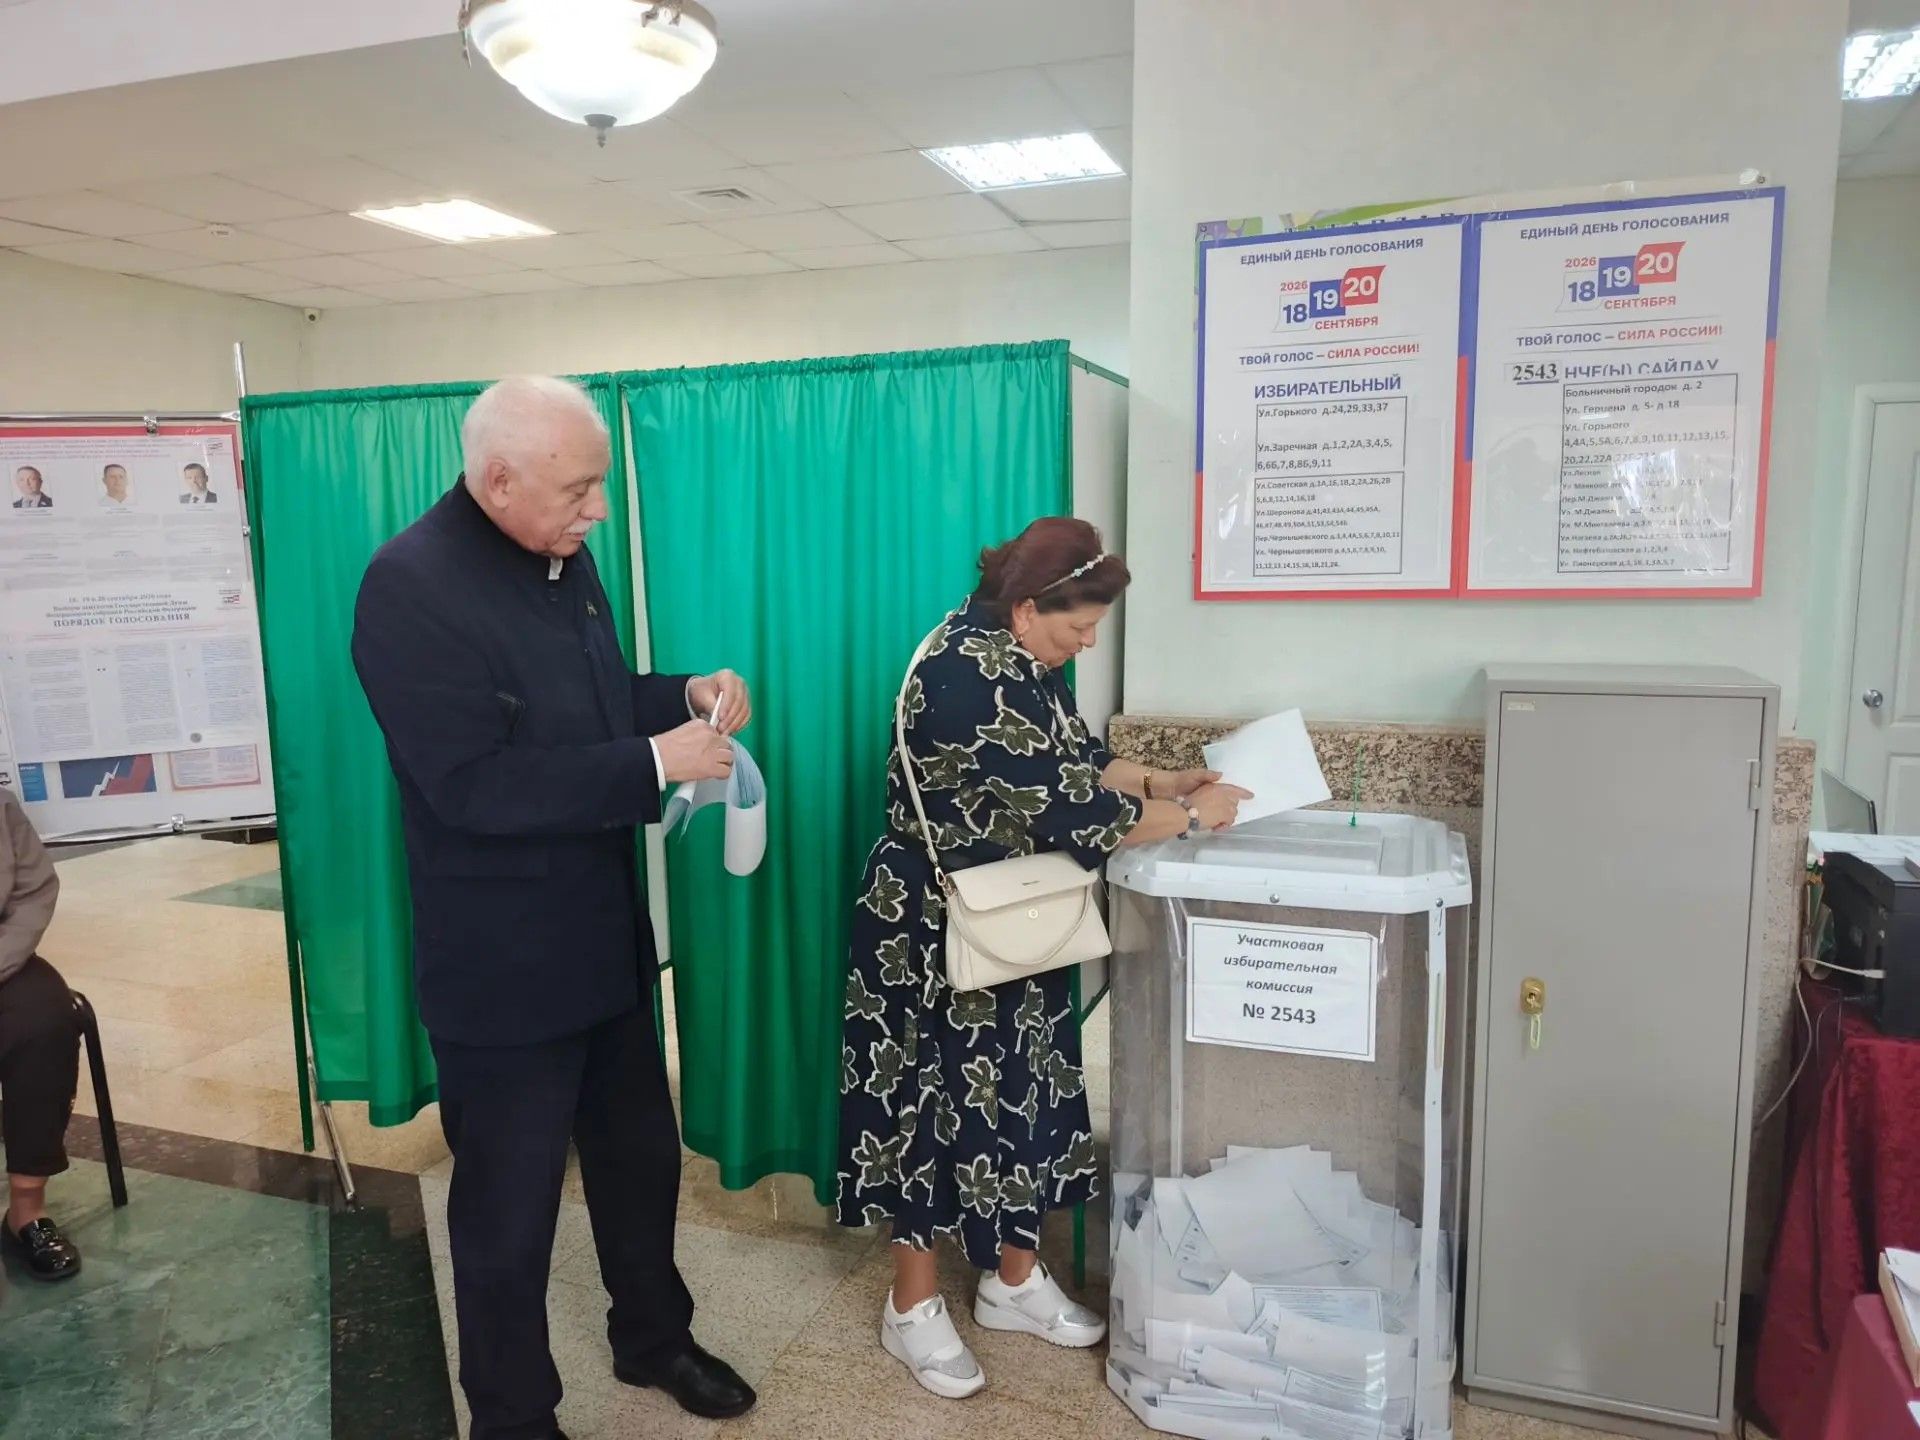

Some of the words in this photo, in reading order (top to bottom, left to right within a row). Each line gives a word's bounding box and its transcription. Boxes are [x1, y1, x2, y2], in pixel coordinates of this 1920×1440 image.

[1520, 223, 1578, 240] ЕДИНЫЙ
[1581, 223, 1618, 236] ДЕНЬ
[1622, 212, 1730, 232] ГОЛОСОВАНИЯ
[1240, 250, 1292, 265] ЕДИНЫЙ
[1294, 248, 1327, 261] ДЕНЬ
[1329, 238, 1424, 257] ГОЛОСОВАНИЯ
[1564, 256, 1597, 268] 2026
[1638, 252, 1674, 276] 20
[1280, 280, 1308, 292] 2026
[1344, 275, 1376, 297] 20
[1602, 266, 1632, 288] 19
[1312, 289, 1339, 310] 19
[1568, 280, 1596, 303] 18
[1604, 295, 1677, 310] СЕНТЯБРЯ
[1282, 303, 1308, 324] 18
[1314, 316, 1379, 330] СЕНТЯБРЯ
[1516, 333, 1552, 347] ТВОЙ
[1556, 332, 1602, 345] ГОЛОС
[1617, 329, 1656, 341] СИЛА
[1659, 325, 1723, 338] РОССИИ!
[1239, 352, 1271, 365] ТВОЙ
[1273, 351, 1314, 363] ГОЛОС
[1327, 348, 1362, 359] СИЛА
[1364, 343, 1420, 357] РОССИИ!
[1512, 363, 1558, 381] 2543
[1254, 373, 1401, 399] ИЗБИРАТЕЛЬНЫЙ
[1565, 385, 1631, 398] Больничный
[1633, 383, 1677, 394] городок
[1696, 380, 1703, 389] 2
[53, 616, 105, 628] ПОРЯДОК
[109, 612, 190, 625] ГОЛОСОВАНИЯ
[1236, 933, 1325, 952] Участковая
[1223, 955, 1338, 975] избирательная
[1246, 979, 1313, 995] комиссия
[1243, 1002, 1265, 1019] №
[1271, 1005, 1316, 1025] 2543
